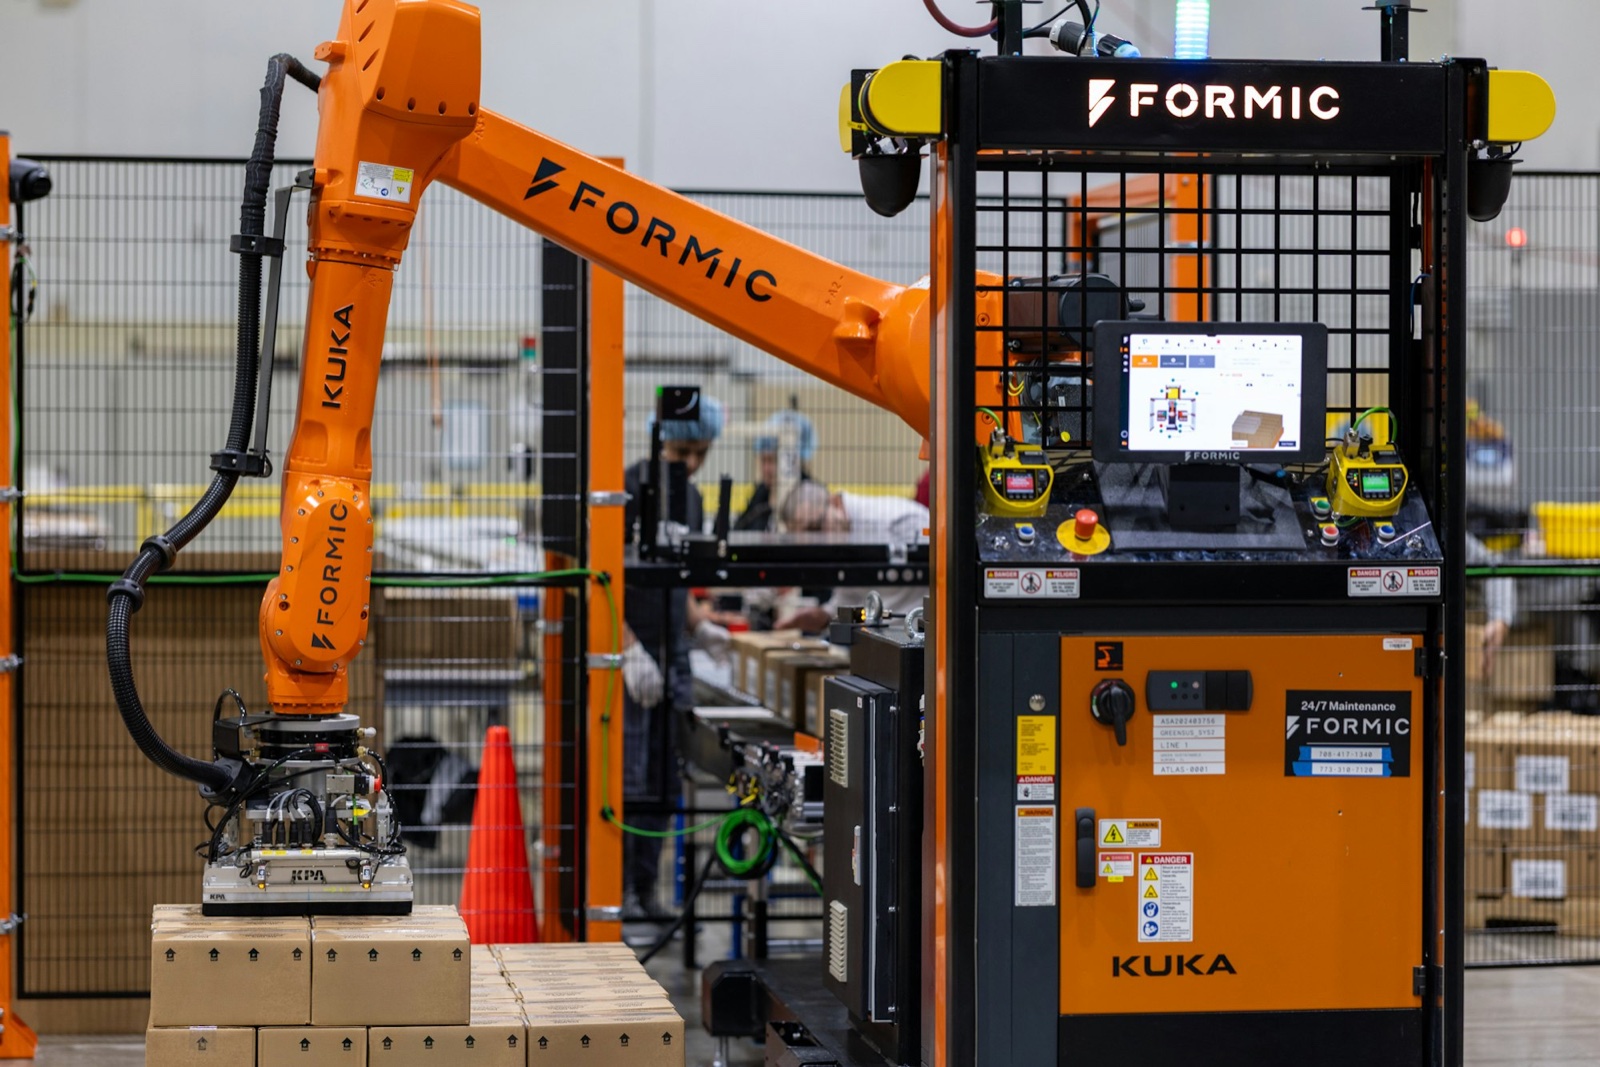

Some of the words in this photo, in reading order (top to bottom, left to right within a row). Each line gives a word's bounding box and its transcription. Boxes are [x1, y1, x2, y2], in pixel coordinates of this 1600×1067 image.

[1129, 83, 1340, 120] FORMIC
[569, 181, 777, 302] FORMIC
[322, 303, 354, 409] KUKA
[1193, 452, 1240, 460] FORMIC
[317, 503, 348, 625] FORMIC
[1301, 701, 1327, 712] 24/7
[1329, 701, 1396, 711] Maintenance
[1307, 717, 1410, 735] FORMIC
[1160, 741, 1180, 749] LINE
[1153, 856, 1188, 864] DANGER
[291, 869, 325, 881] KPA
[209, 893, 226, 901] KPA
[1112, 954, 1237, 978] KUKA
